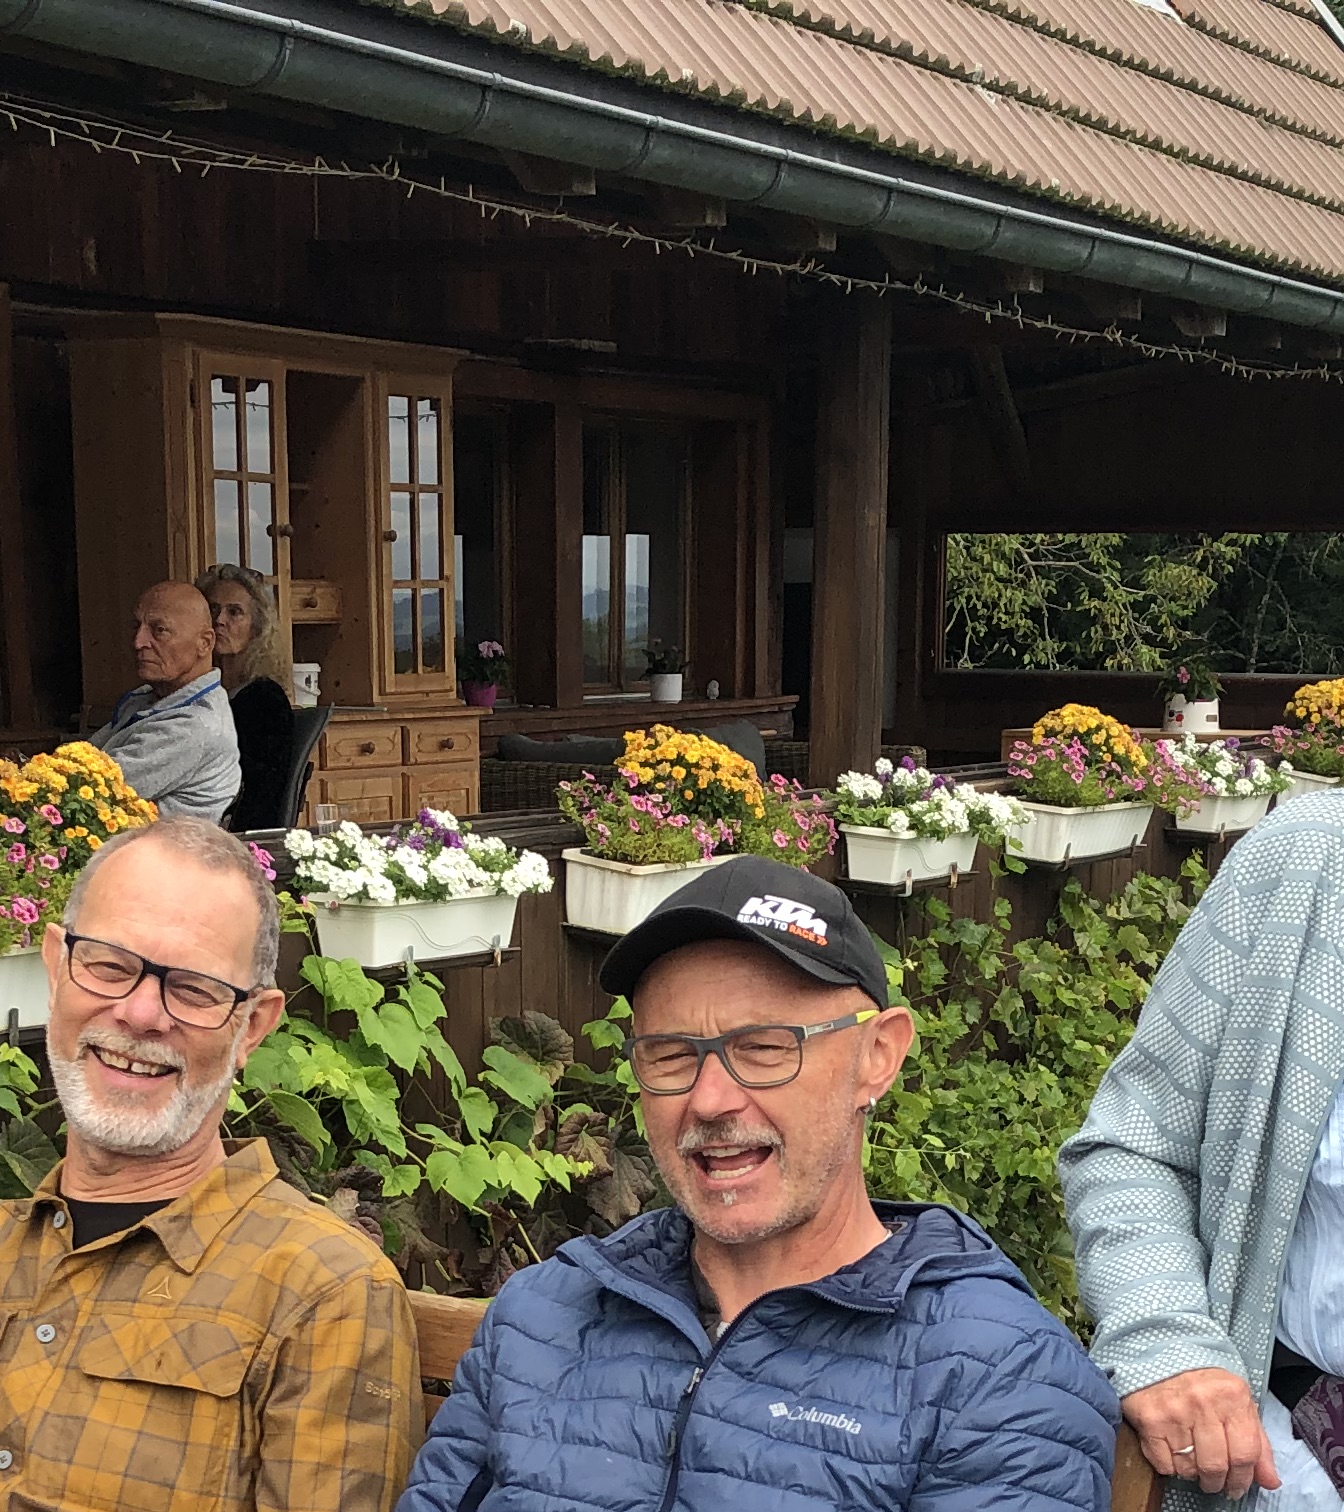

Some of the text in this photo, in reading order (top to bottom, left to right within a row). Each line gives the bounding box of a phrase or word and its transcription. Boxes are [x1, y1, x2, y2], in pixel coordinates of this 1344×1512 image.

[737, 914, 817, 941] READY TO RACE
[739, 894, 827, 936] KTM
[788, 1405, 862, 1435] Columbia
